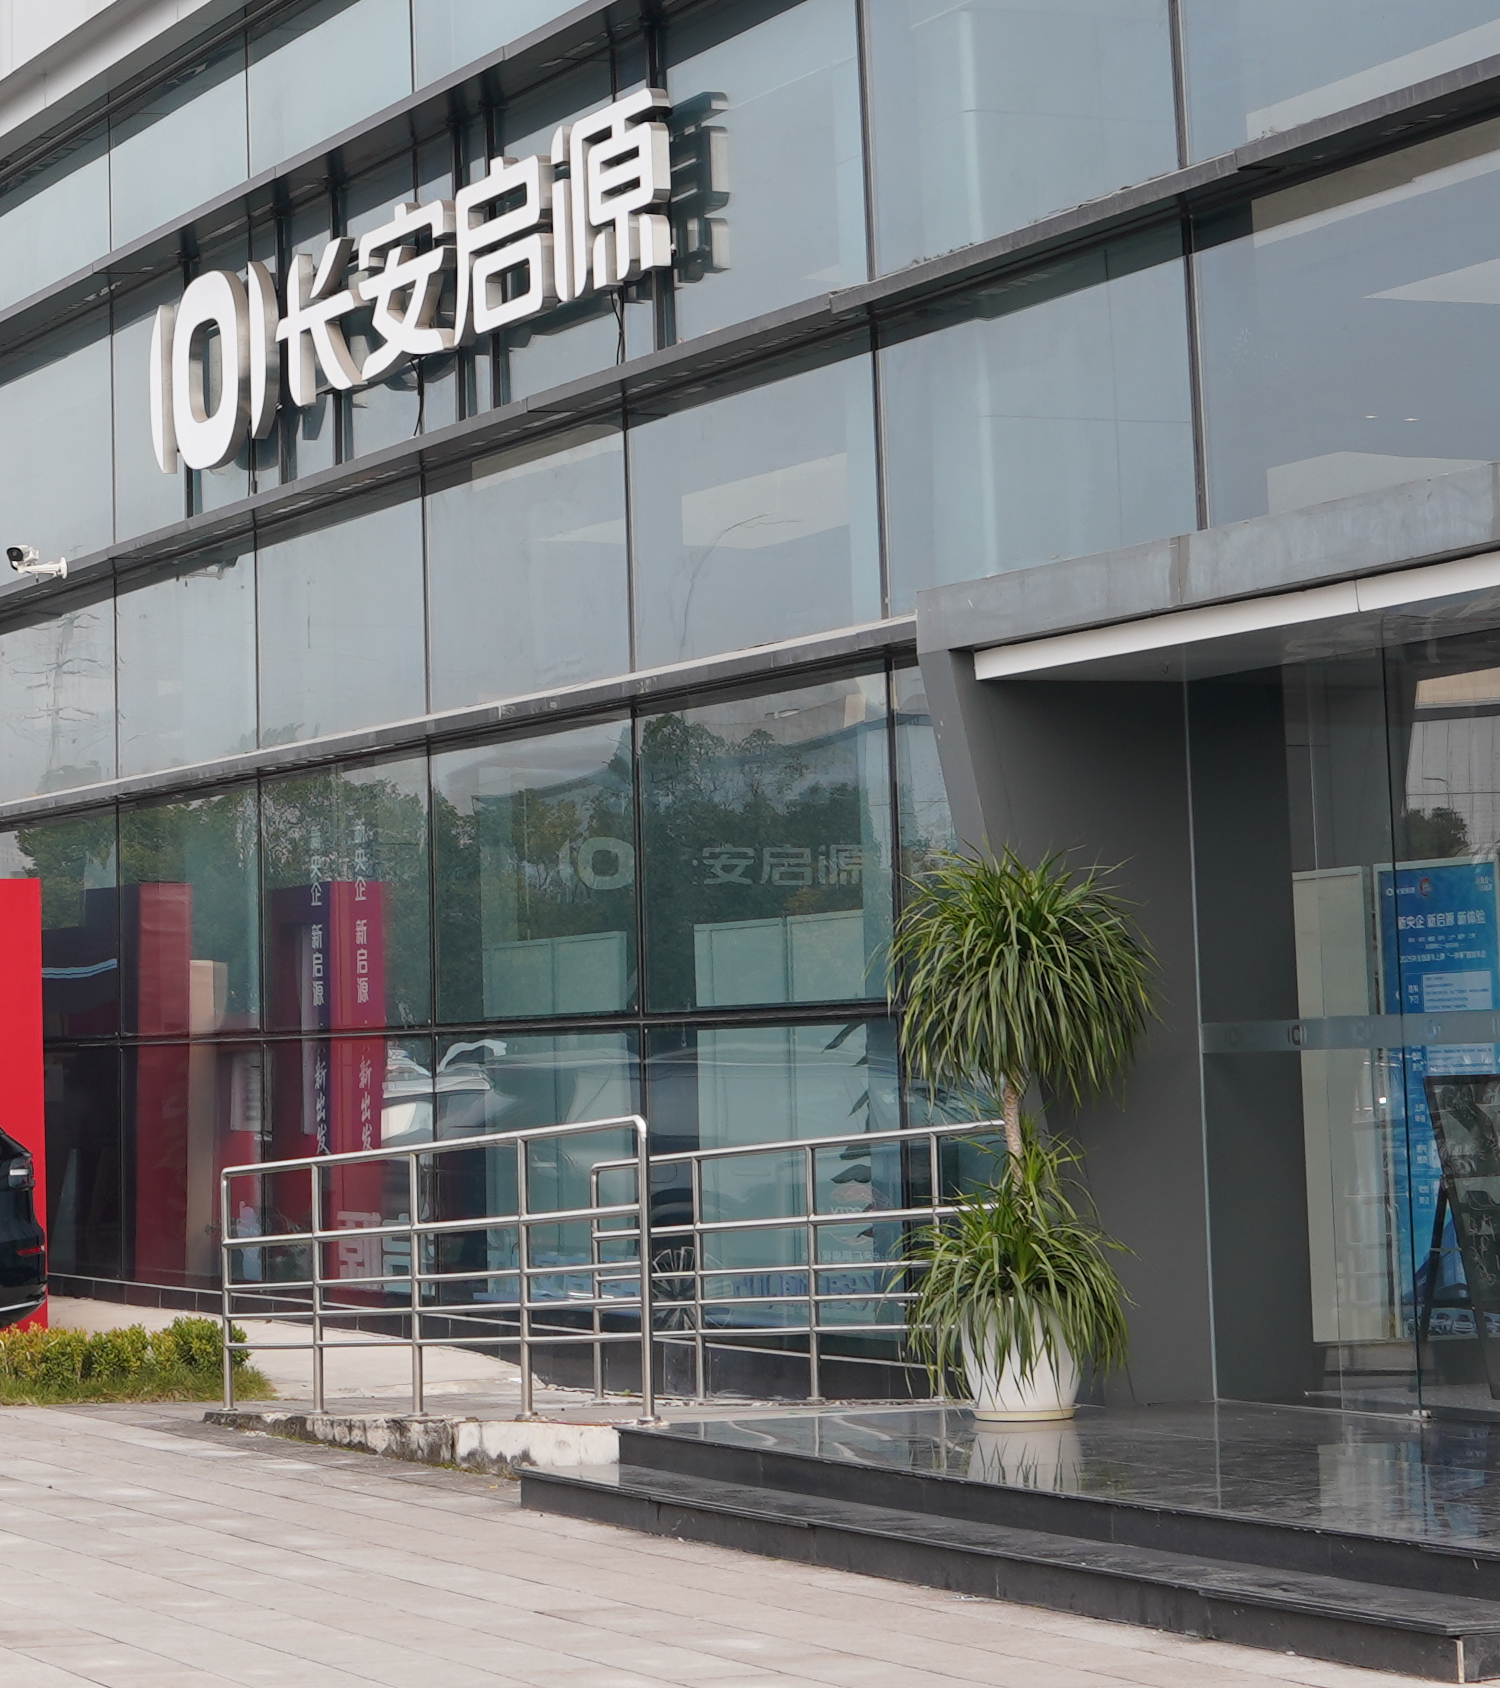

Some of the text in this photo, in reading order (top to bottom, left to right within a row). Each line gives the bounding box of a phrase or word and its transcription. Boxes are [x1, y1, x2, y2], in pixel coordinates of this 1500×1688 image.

[276, 87, 671, 406] 长安启源
[692, 844, 862, 886] 安启源
[311, 923, 325, 1007] 新启源
[355, 919, 369, 1003] 新启源
